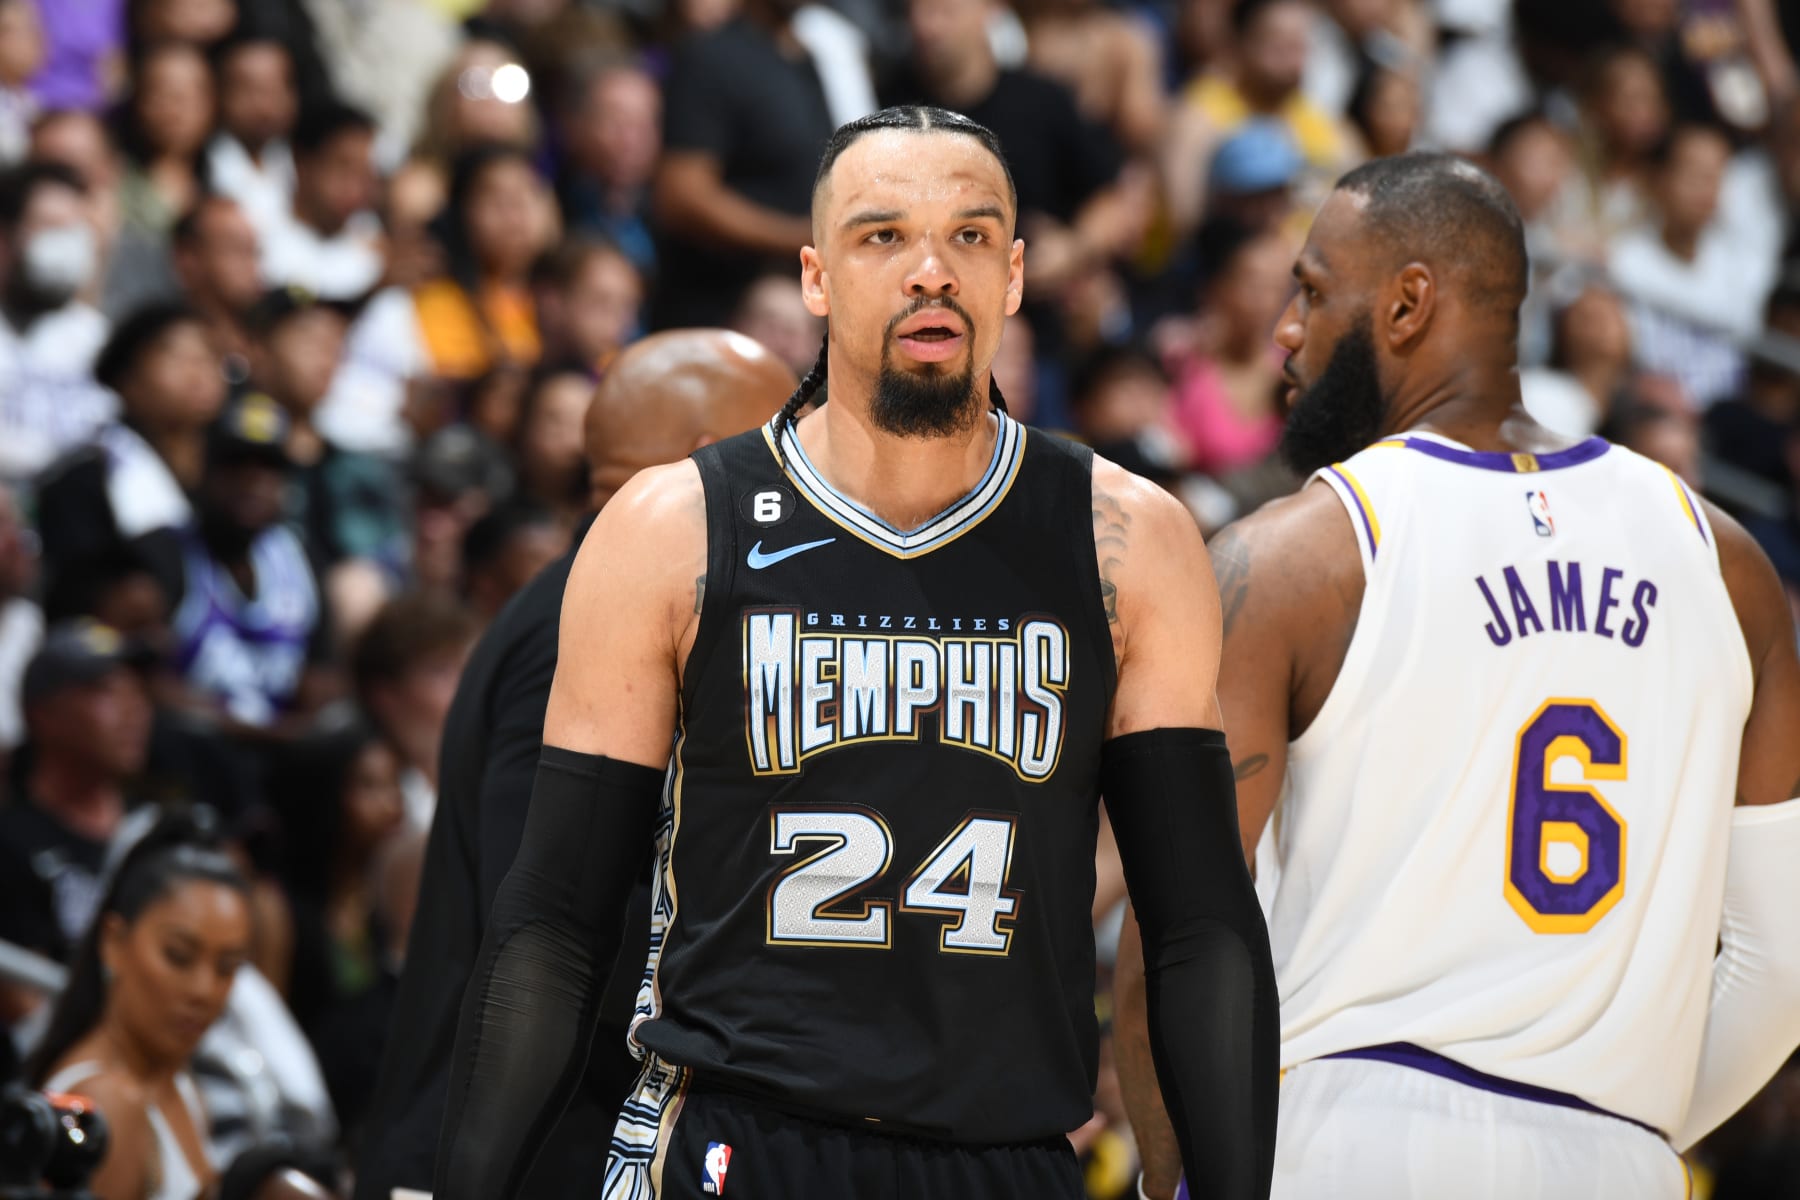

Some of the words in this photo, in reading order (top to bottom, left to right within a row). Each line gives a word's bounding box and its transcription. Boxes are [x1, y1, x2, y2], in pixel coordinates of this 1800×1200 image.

[753, 491, 782, 522] 6
[806, 612, 1010, 631] GRIZZLIES
[1475, 560, 1658, 648] JAMES
[743, 608, 1070, 783] MEMPHIS
[1503, 696, 1628, 935] 6
[766, 805, 1023, 956] 24
